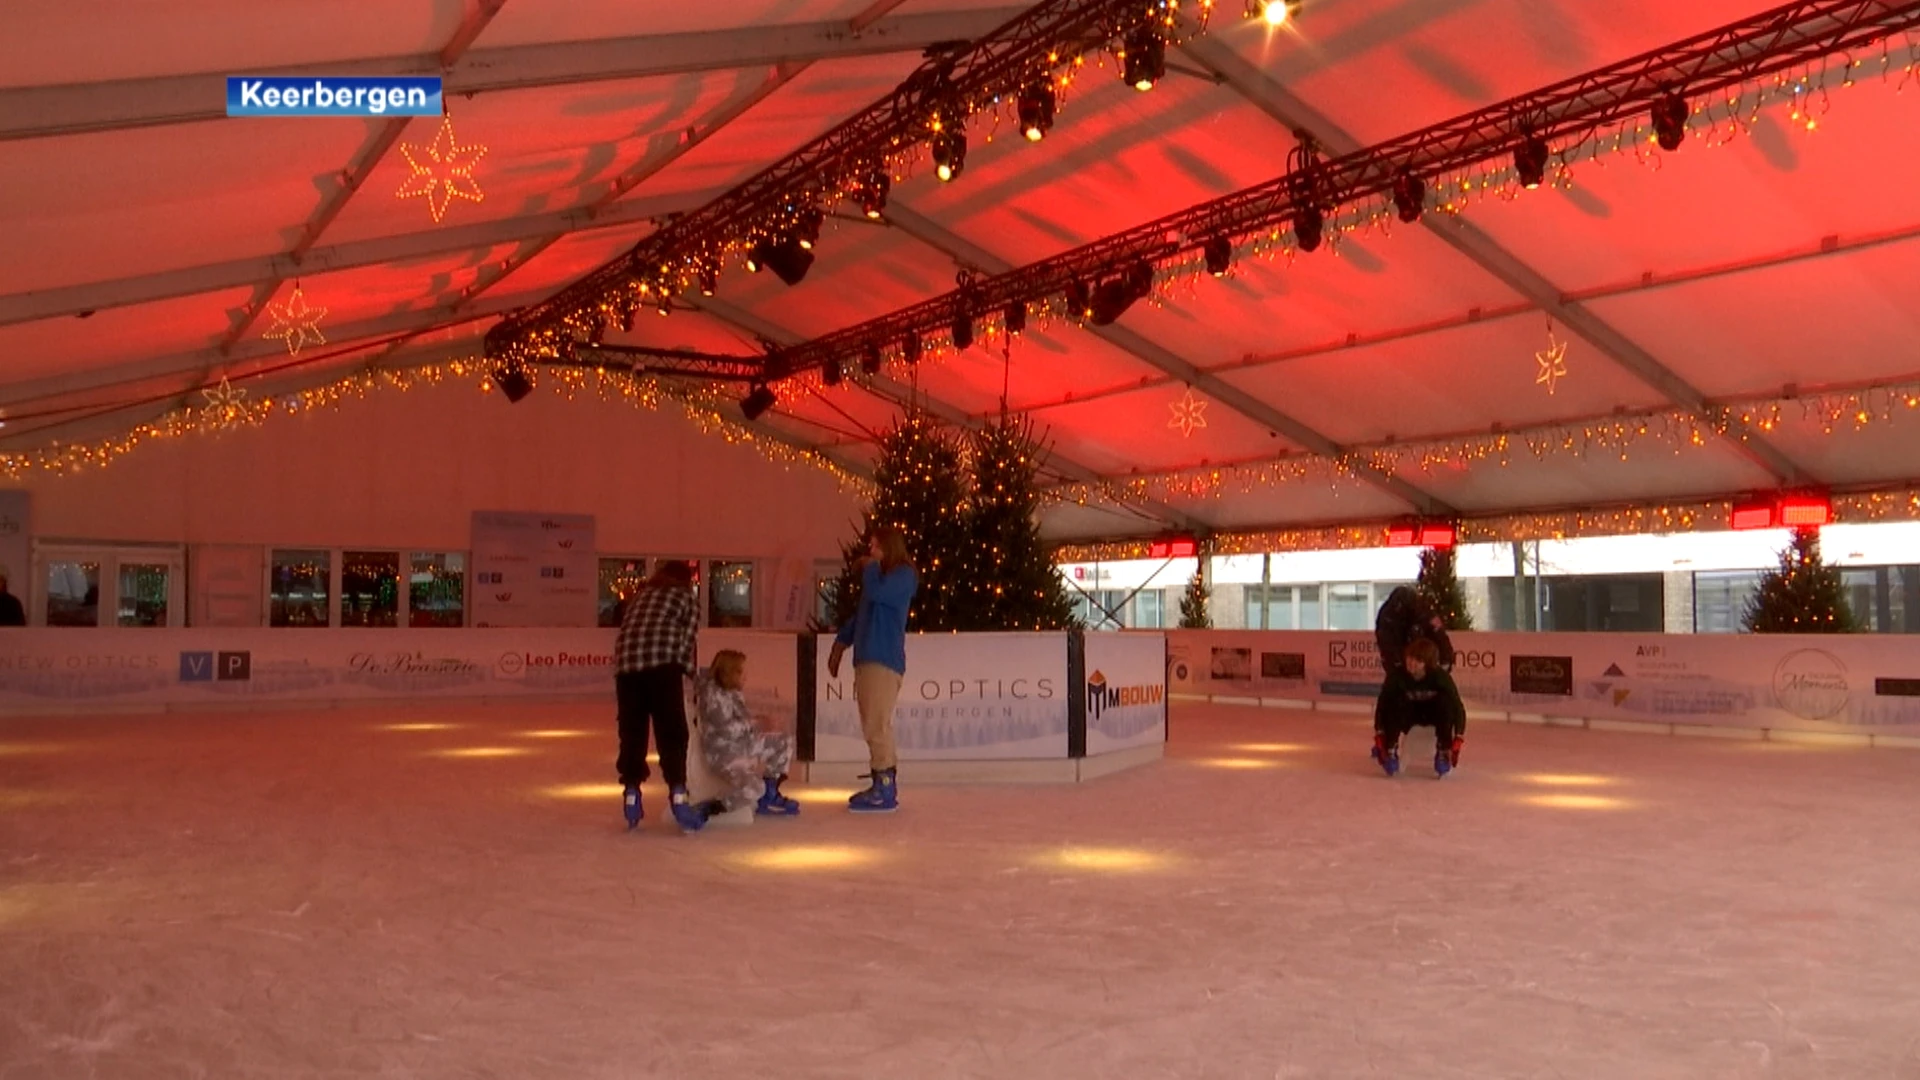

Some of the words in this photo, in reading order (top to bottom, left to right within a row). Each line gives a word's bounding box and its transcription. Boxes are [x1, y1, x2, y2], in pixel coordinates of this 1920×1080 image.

[0, 656, 54, 670] NEW
[66, 655, 159, 670] OPTICS
[188, 655, 205, 677] V
[228, 655, 243, 676] P
[525, 652, 555, 666] Leo
[1350, 655, 1382, 669] BOGA
[1453, 650, 1496, 669] nea
[919, 677, 1056, 701] OPTICS
[895, 705, 1014, 720] ERBERGEN
